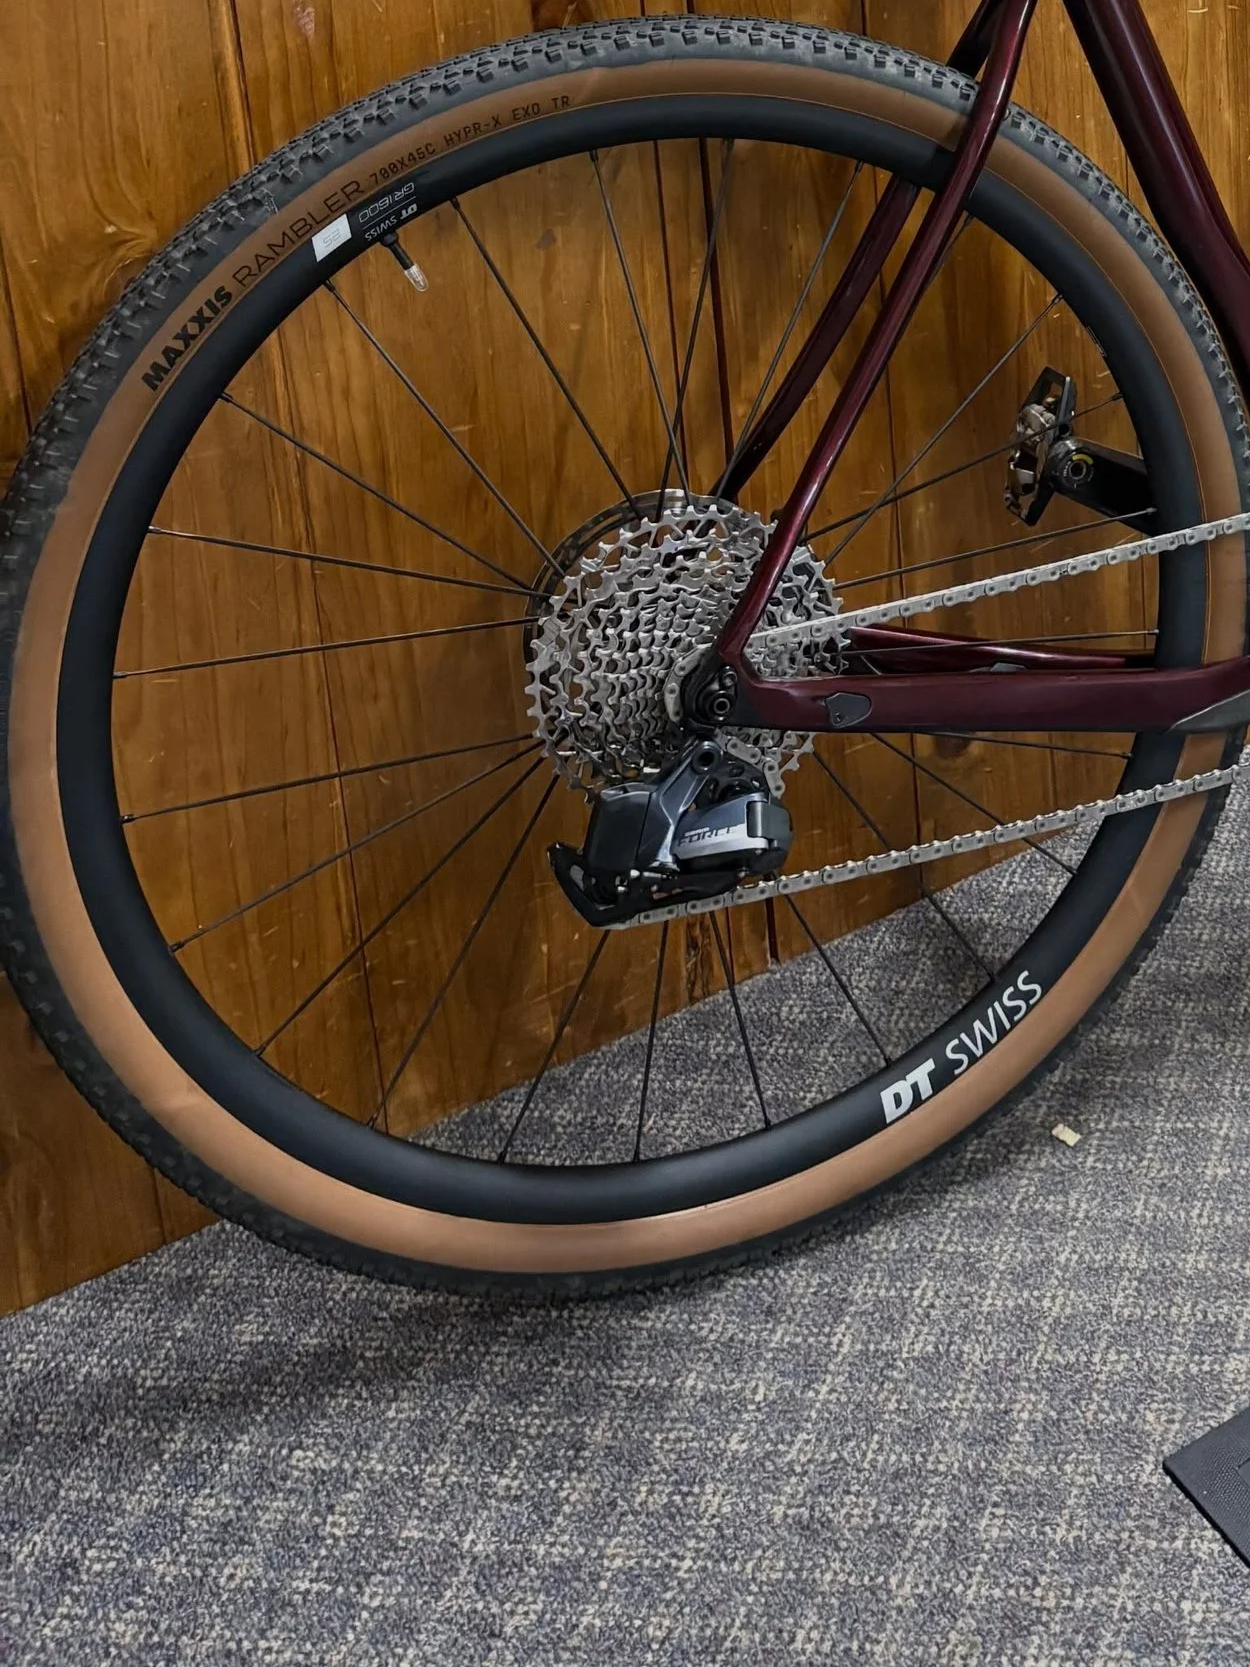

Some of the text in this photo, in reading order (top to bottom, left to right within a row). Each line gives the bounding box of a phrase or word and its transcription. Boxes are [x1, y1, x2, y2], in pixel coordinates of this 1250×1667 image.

[141, 95, 570, 392] MAXXIS RAMBLER 700X45C HYPR-X EXO TR
[365, 203, 417, 241] DT SWISS
[677, 826, 740, 847] FORCE
[880, 970, 1042, 1125] DT SWISS
